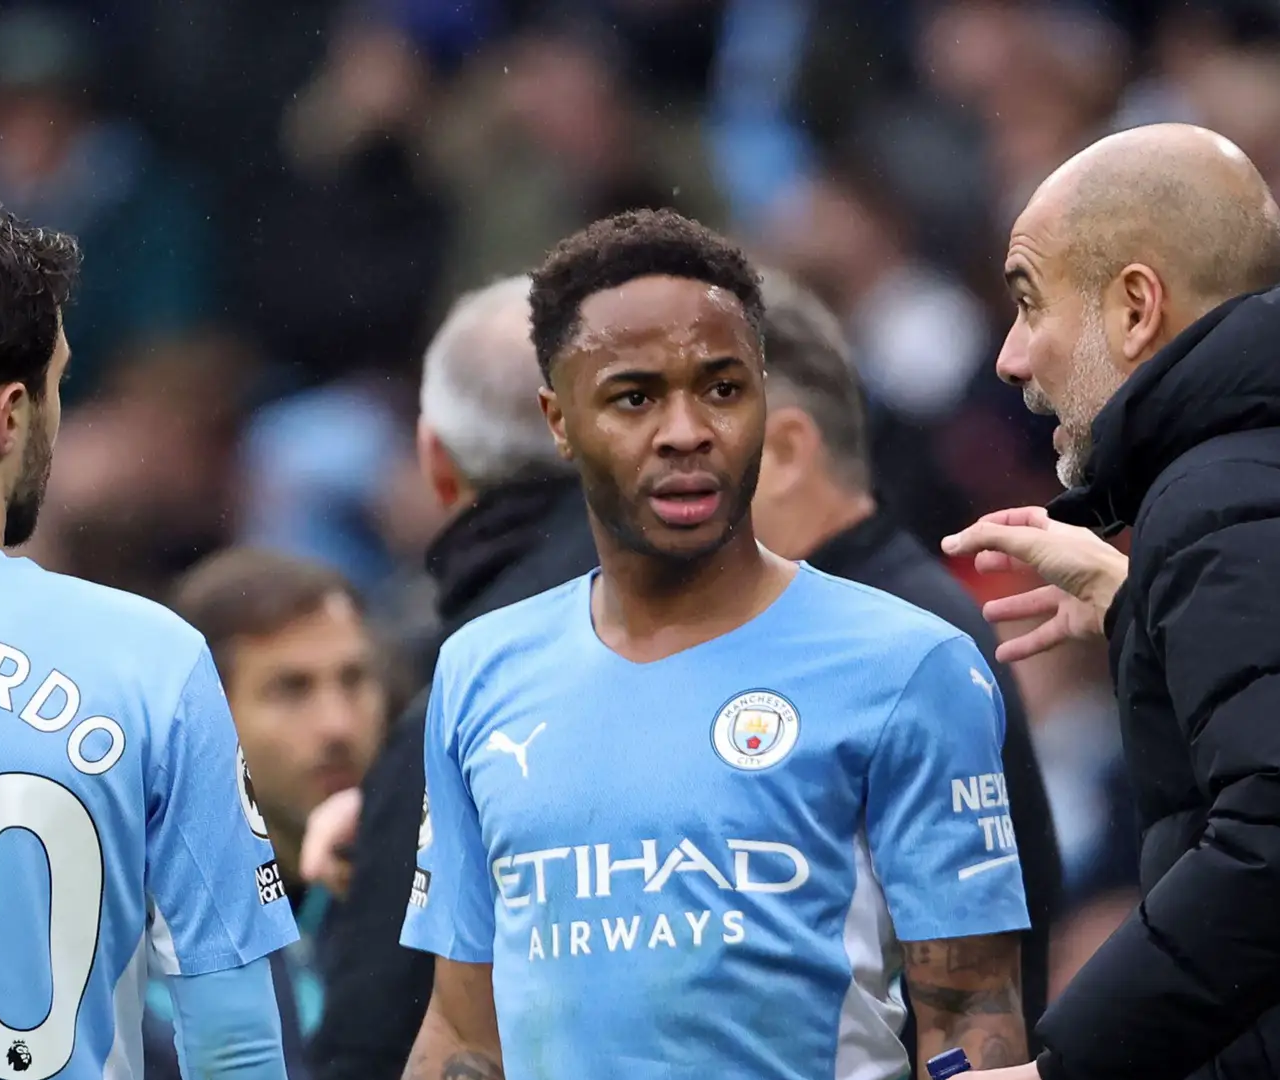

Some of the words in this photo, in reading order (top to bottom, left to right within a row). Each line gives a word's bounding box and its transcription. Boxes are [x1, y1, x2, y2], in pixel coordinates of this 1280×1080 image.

[724, 695, 794, 723] MANCHESTER
[737, 756, 763, 765] CITY
[491, 838, 810, 908] ETIHAD
[528, 910, 745, 961] AIRWAYS
